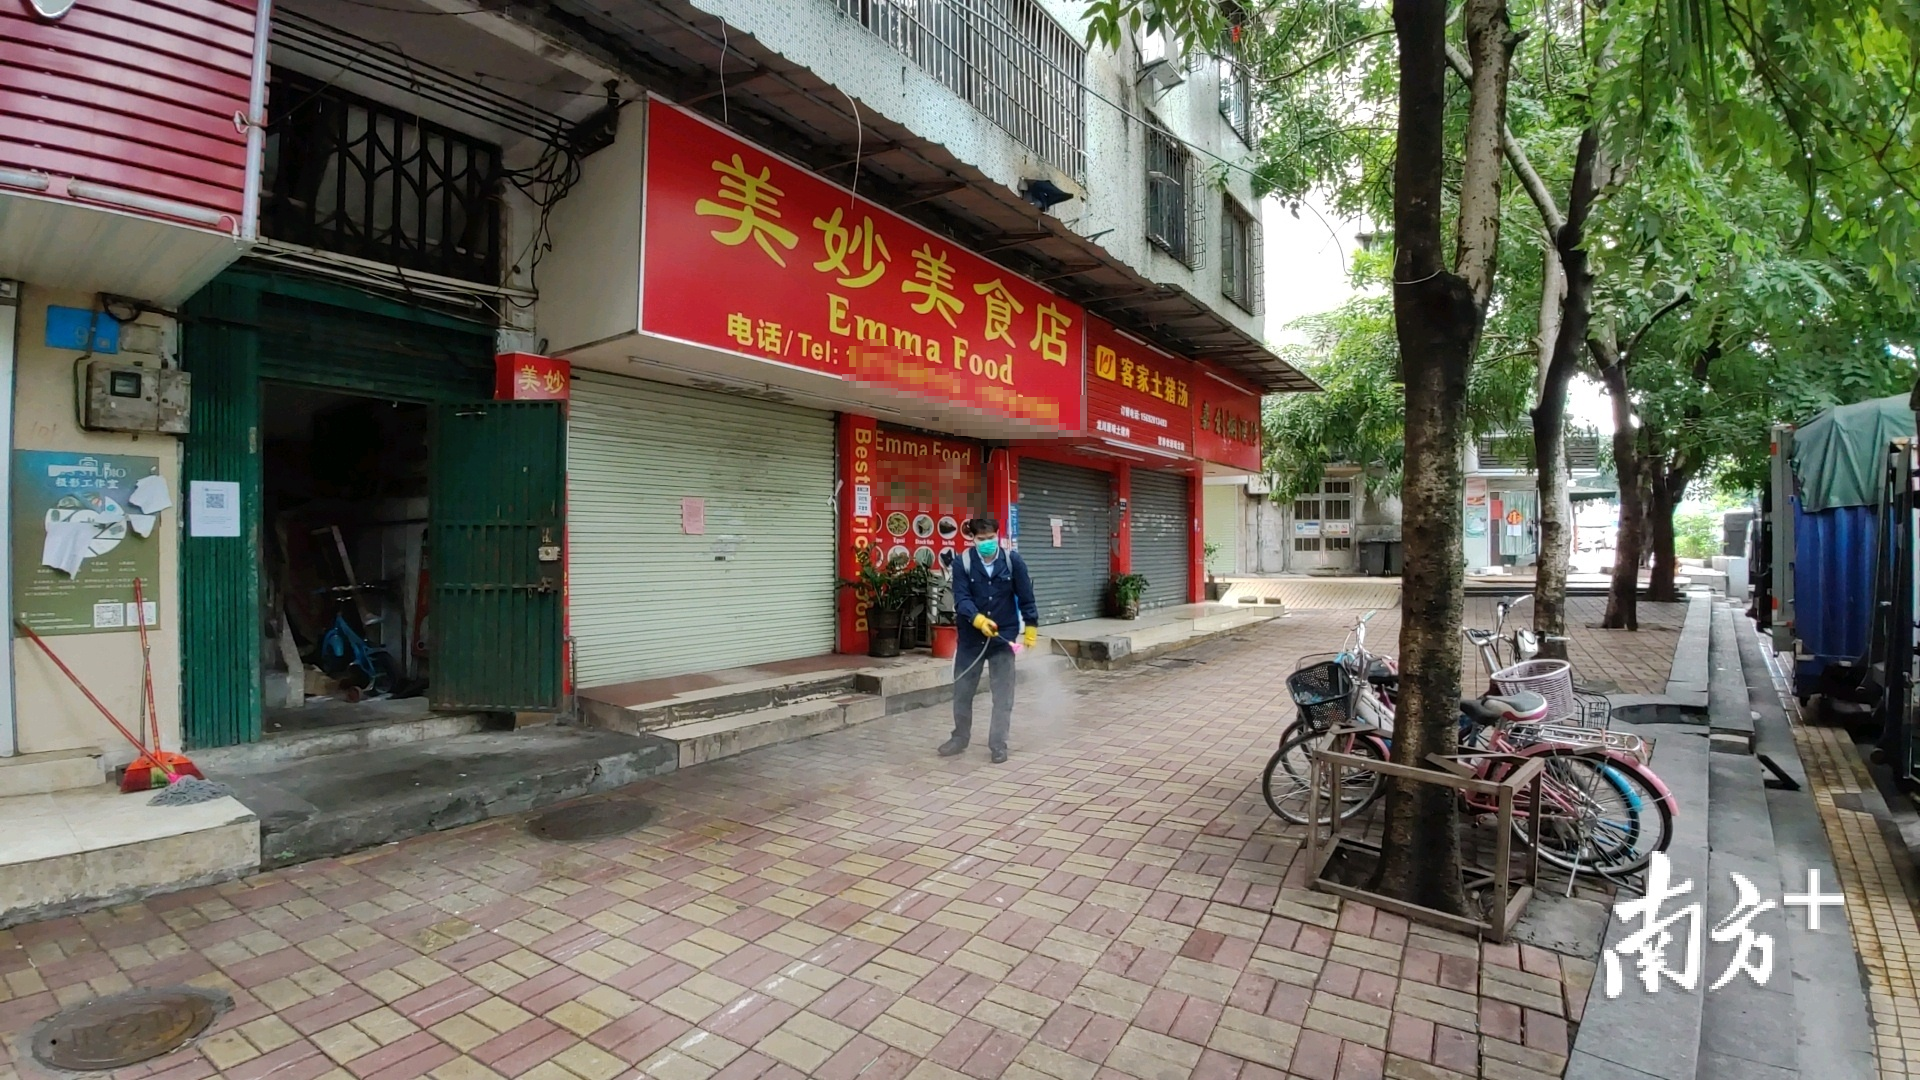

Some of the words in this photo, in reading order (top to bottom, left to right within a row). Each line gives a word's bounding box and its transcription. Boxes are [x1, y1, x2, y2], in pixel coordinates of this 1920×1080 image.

[695, 153, 1072, 367] 美妙美食店
[827, 293, 943, 364] Emma
[952, 336, 1014, 386] Food
[518, 364, 565, 394] 美妙
[1120, 357, 1188, 408] 客家土猪汤
[855, 428, 872, 484] Best
[875, 430, 927, 457] Emma
[933, 441, 970, 465] Food
[55, 477, 119, 489] 摄影工作室
